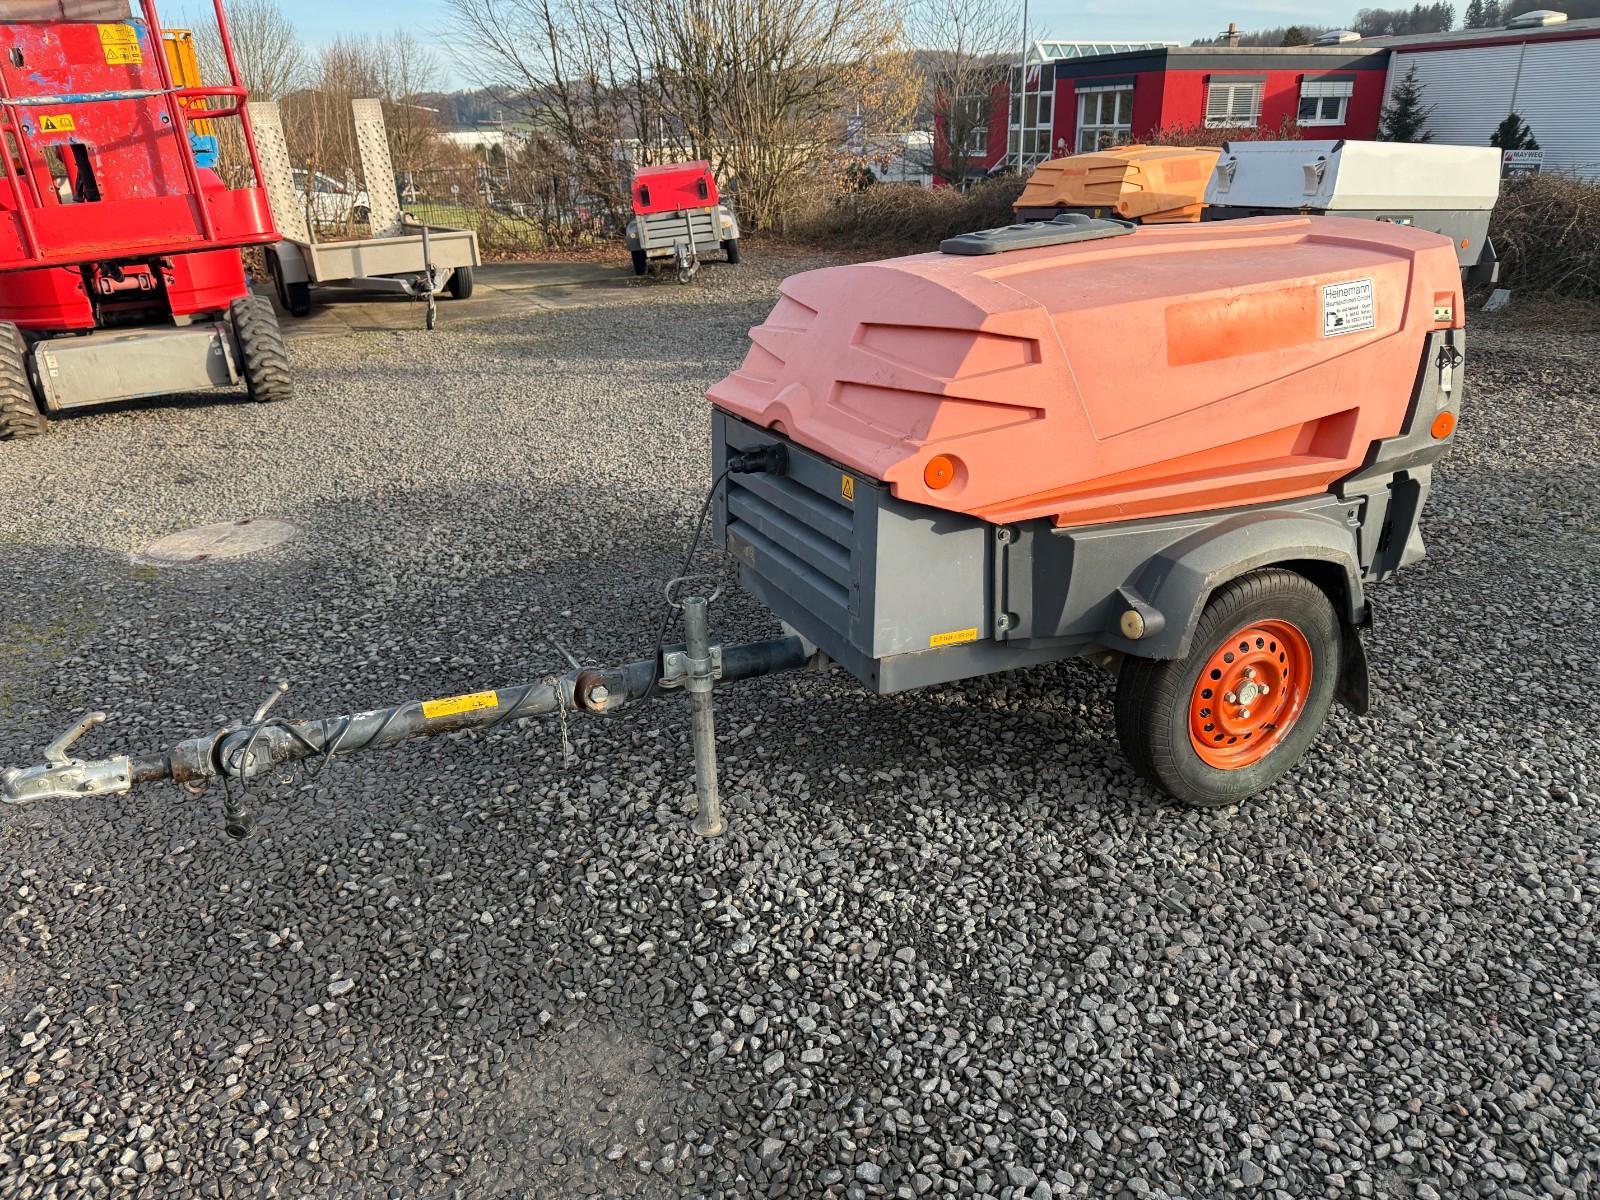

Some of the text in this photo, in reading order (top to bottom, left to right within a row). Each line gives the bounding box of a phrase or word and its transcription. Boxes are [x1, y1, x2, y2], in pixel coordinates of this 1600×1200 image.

[1325, 284, 1370, 300] Heinemann
[1325, 294, 1371, 307] Baumaschinen GmbH
